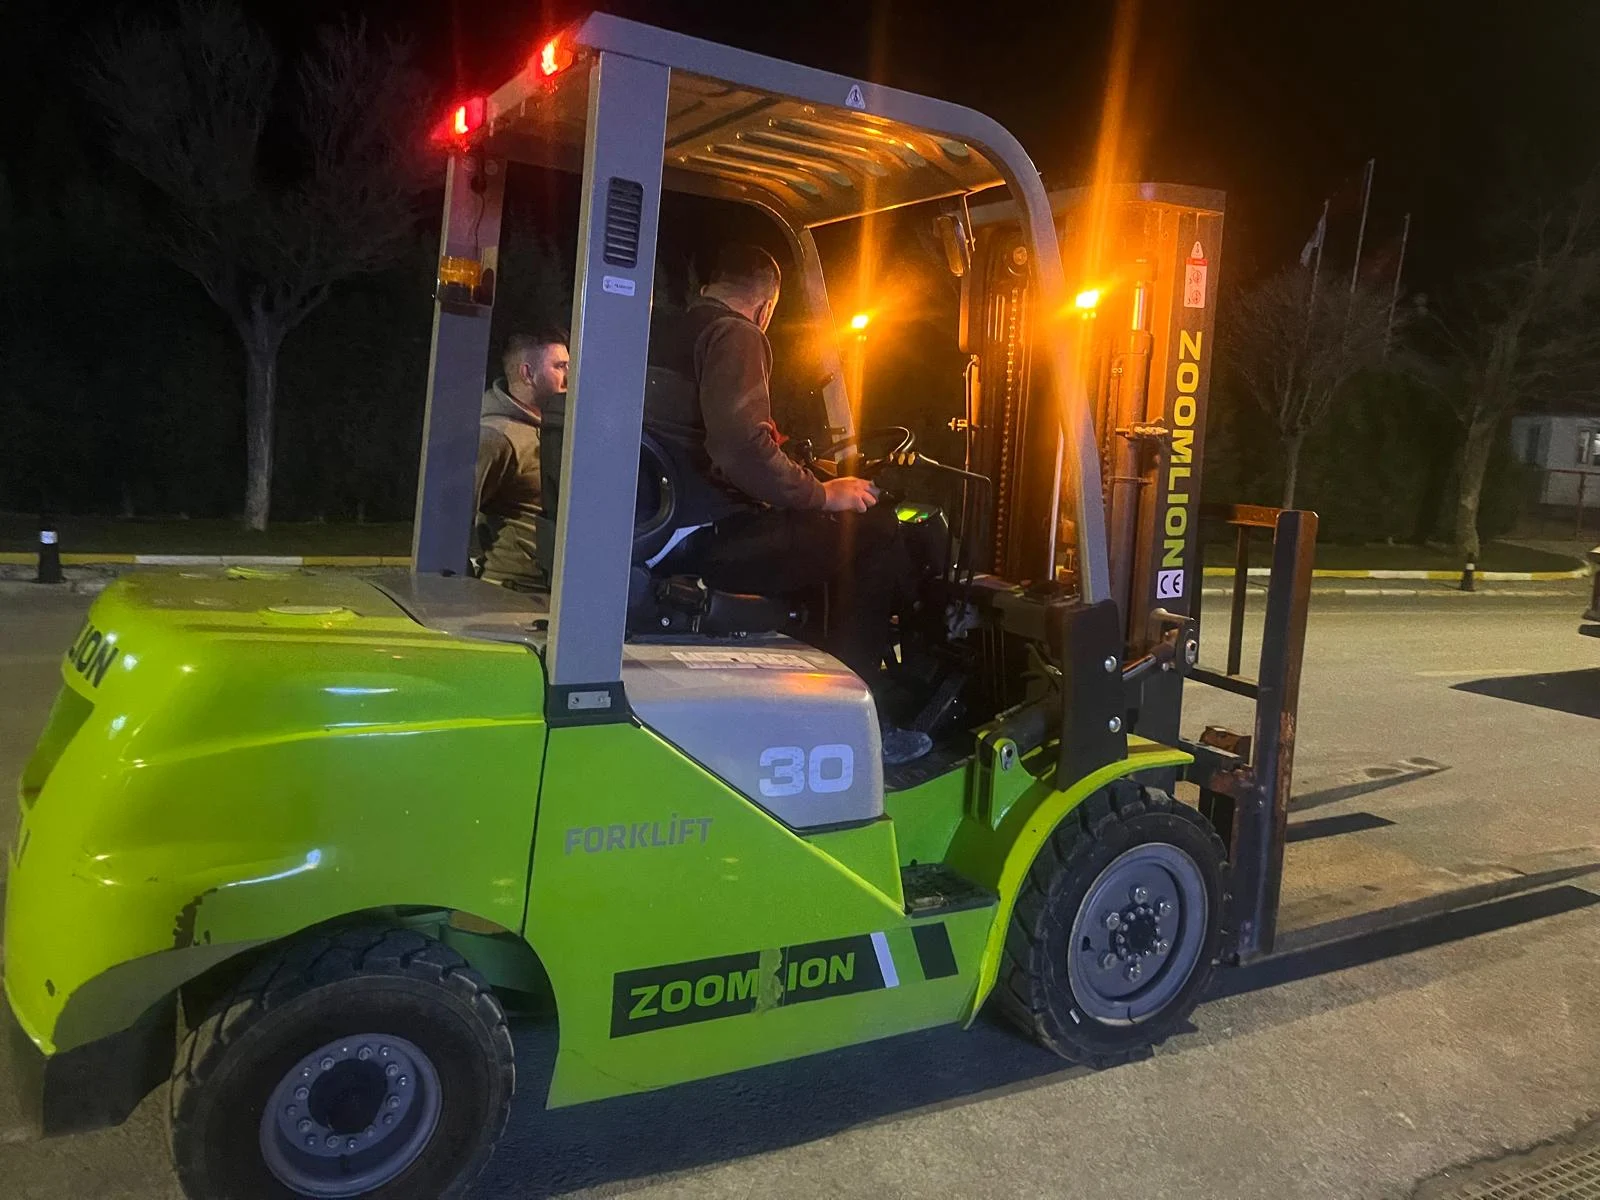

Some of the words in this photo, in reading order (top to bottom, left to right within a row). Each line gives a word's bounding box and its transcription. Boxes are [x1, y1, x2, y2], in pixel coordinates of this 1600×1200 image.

[1162, 330, 1202, 567] ZOOMLION
[1160, 573, 1181, 595] CE
[759, 744, 854, 797] 30
[629, 953, 855, 1020] ZOOMION
